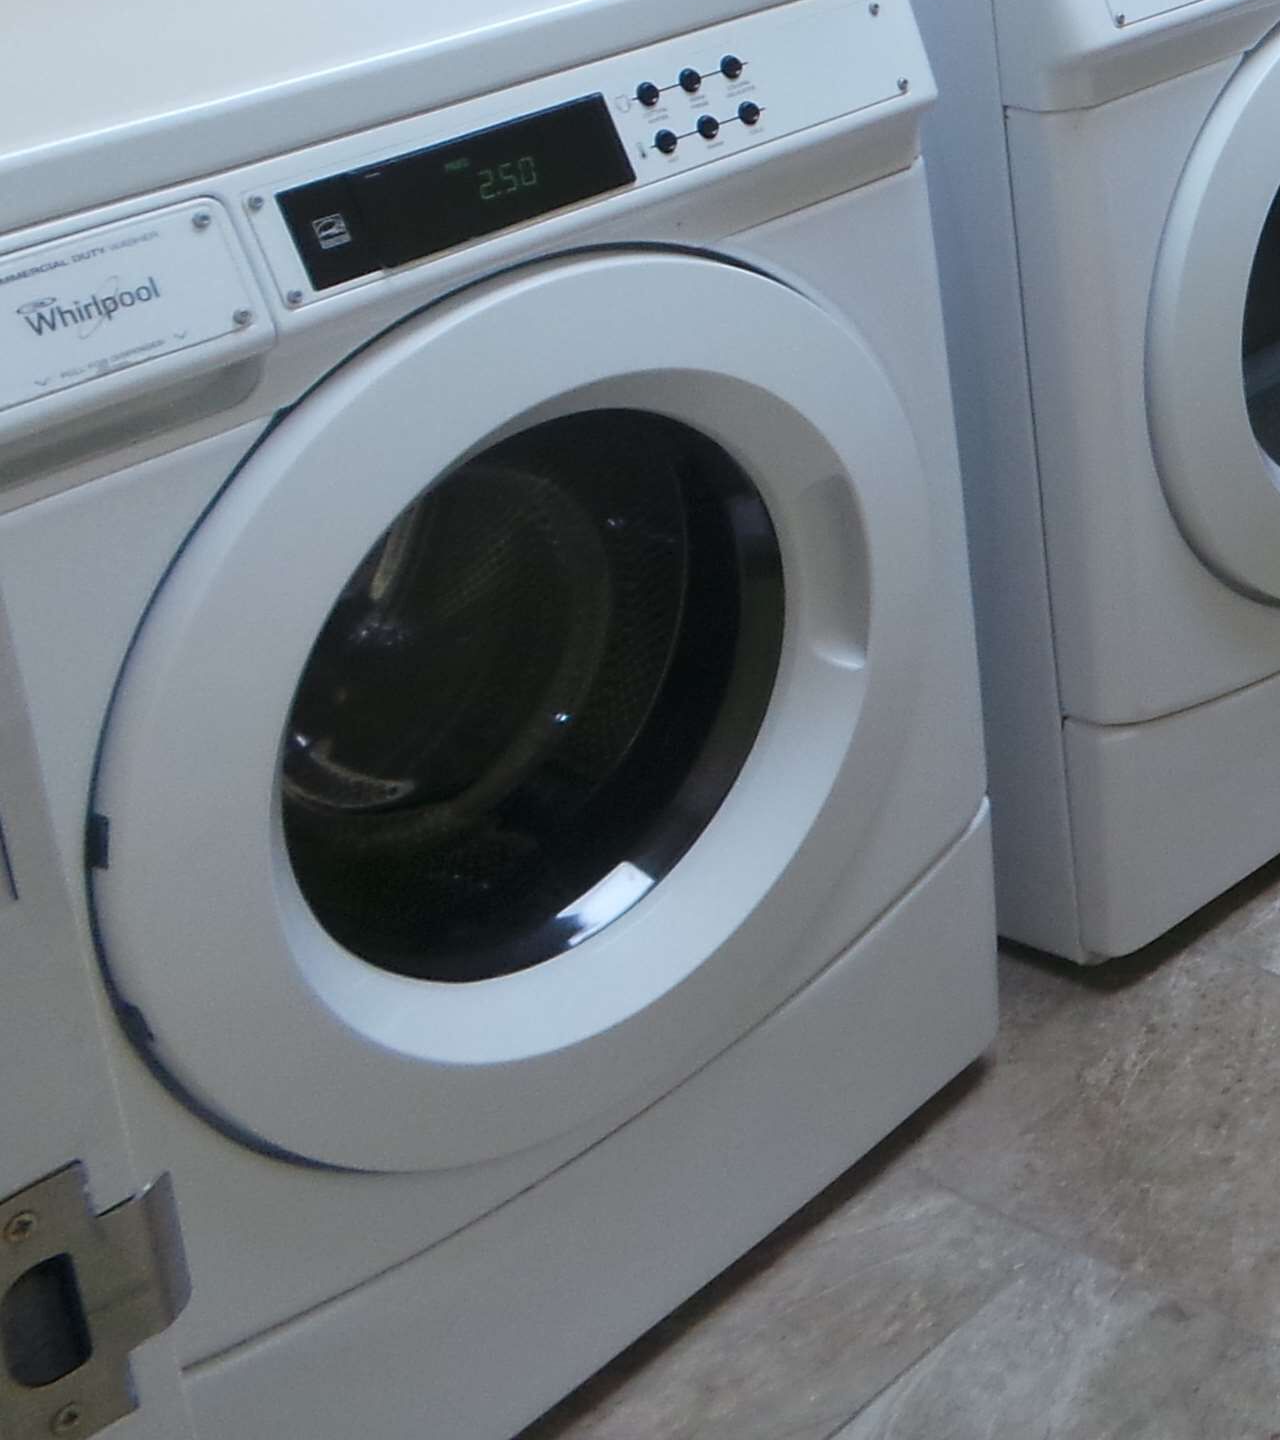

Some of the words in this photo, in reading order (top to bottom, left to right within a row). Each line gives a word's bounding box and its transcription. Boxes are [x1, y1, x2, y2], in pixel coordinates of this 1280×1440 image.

[478, 156, 536, 200] 2.50
[71, 247, 105, 263] DUTY
[24, 276, 162, 336] Whirlpool
